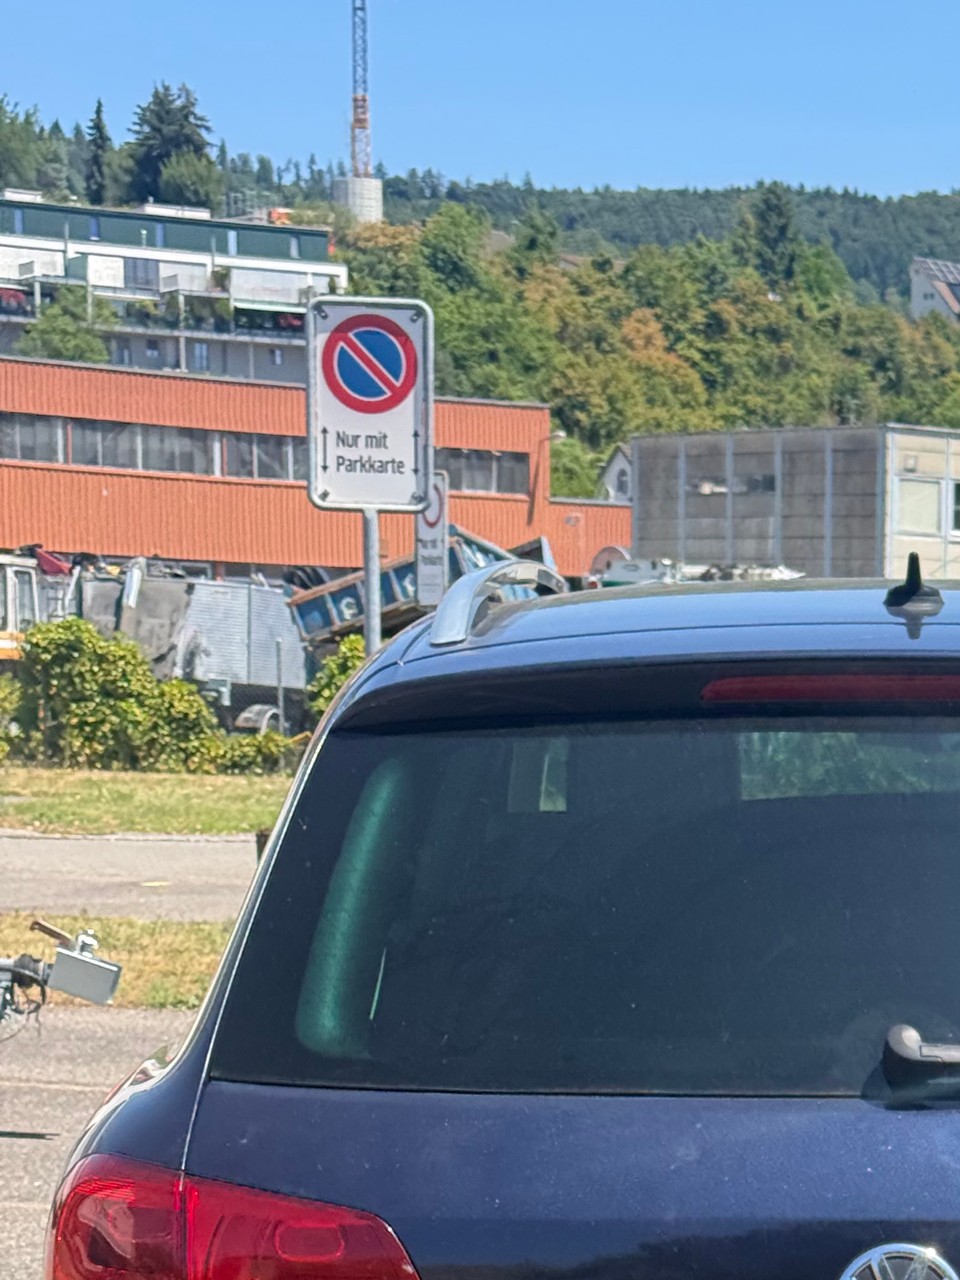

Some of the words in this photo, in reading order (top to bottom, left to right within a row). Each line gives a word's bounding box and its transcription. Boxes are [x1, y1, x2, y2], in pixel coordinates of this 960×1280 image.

[336, 430, 361, 448] Nur
[365, 431, 388, 449] mit
[336, 455, 405, 474] Parkkarte
